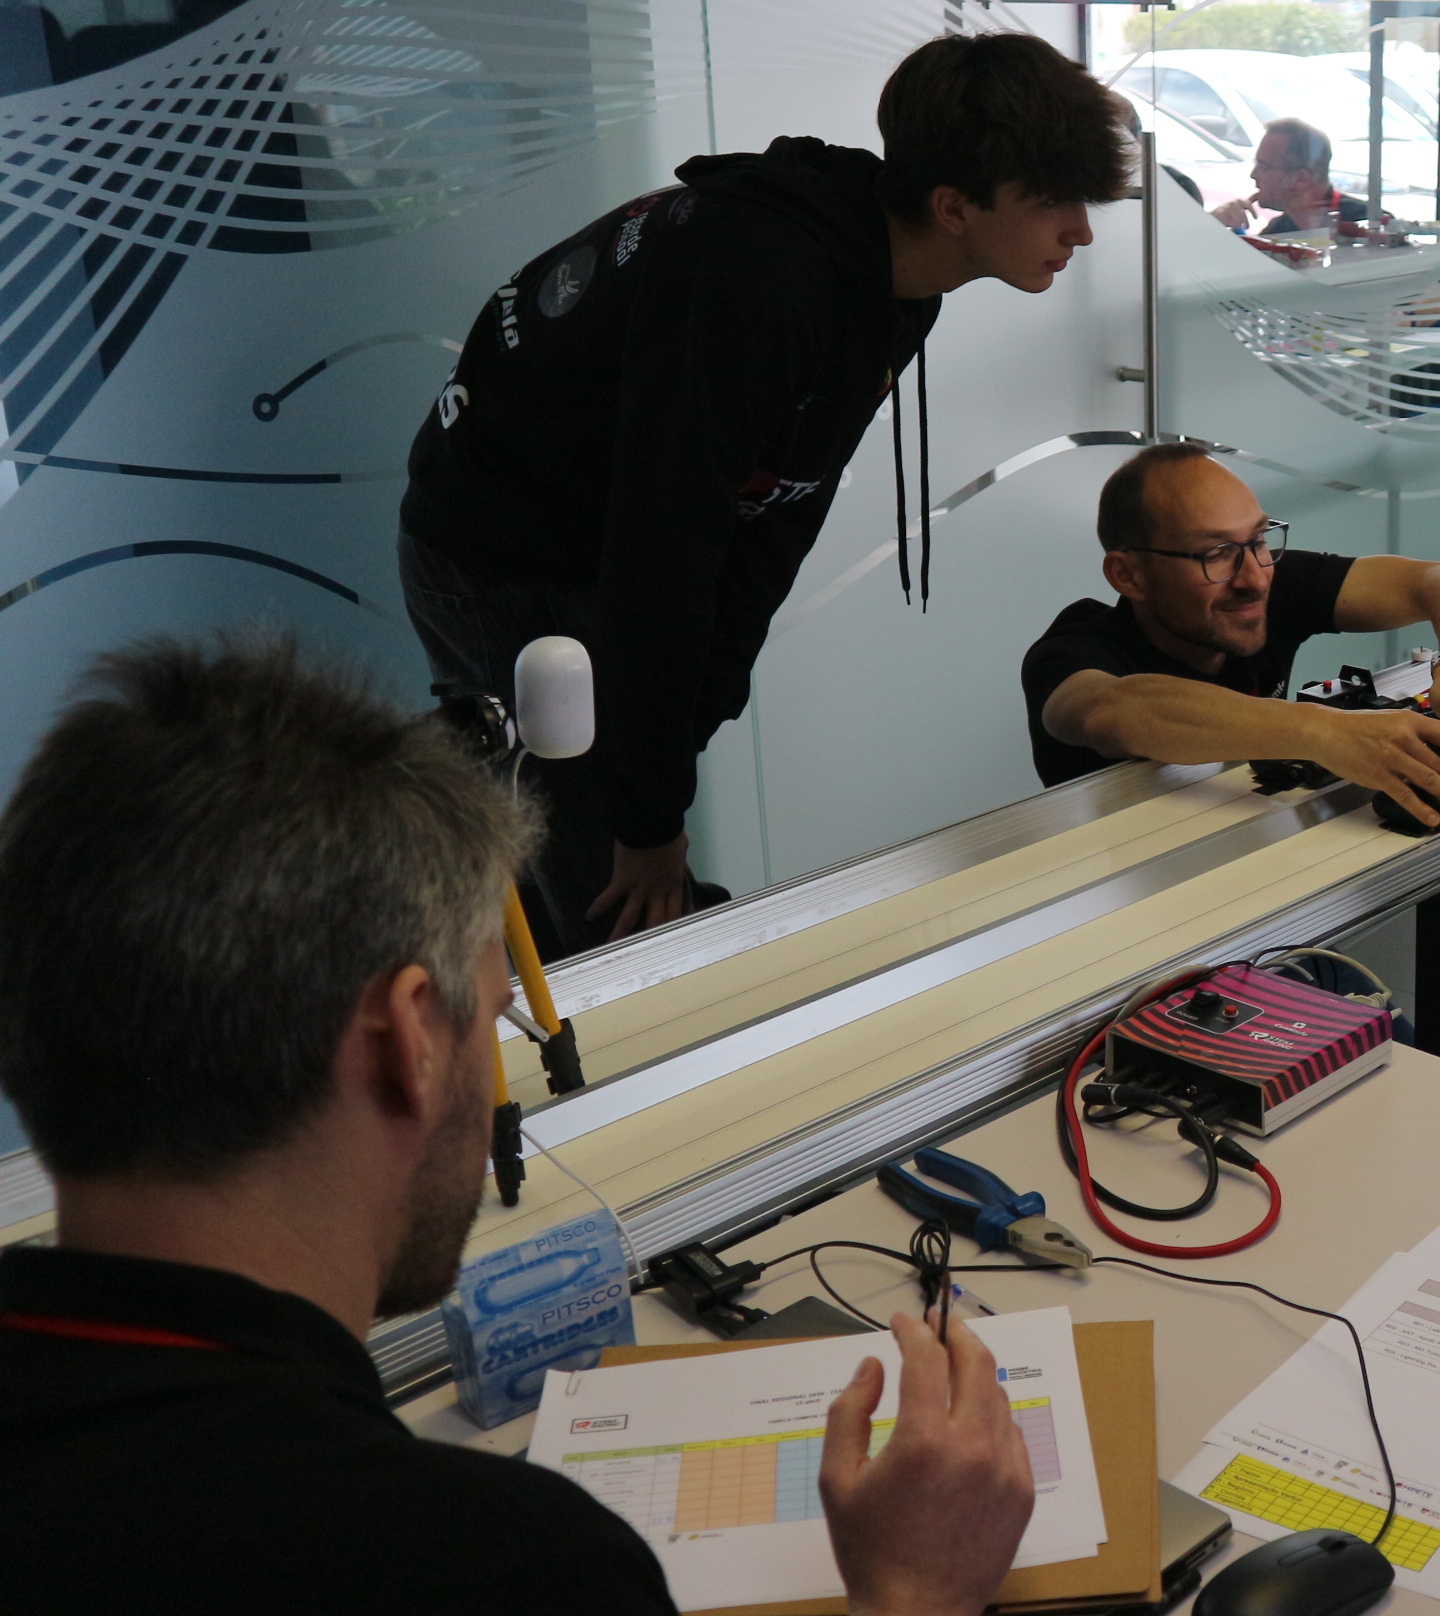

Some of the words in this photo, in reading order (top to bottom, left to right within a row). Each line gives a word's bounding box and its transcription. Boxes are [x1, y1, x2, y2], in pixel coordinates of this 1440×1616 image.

[535, 1220, 596, 1251] PITSCO
[541, 1284, 622, 1327] PITSCO
[482, 1306, 620, 1374] CARTRIDGES
